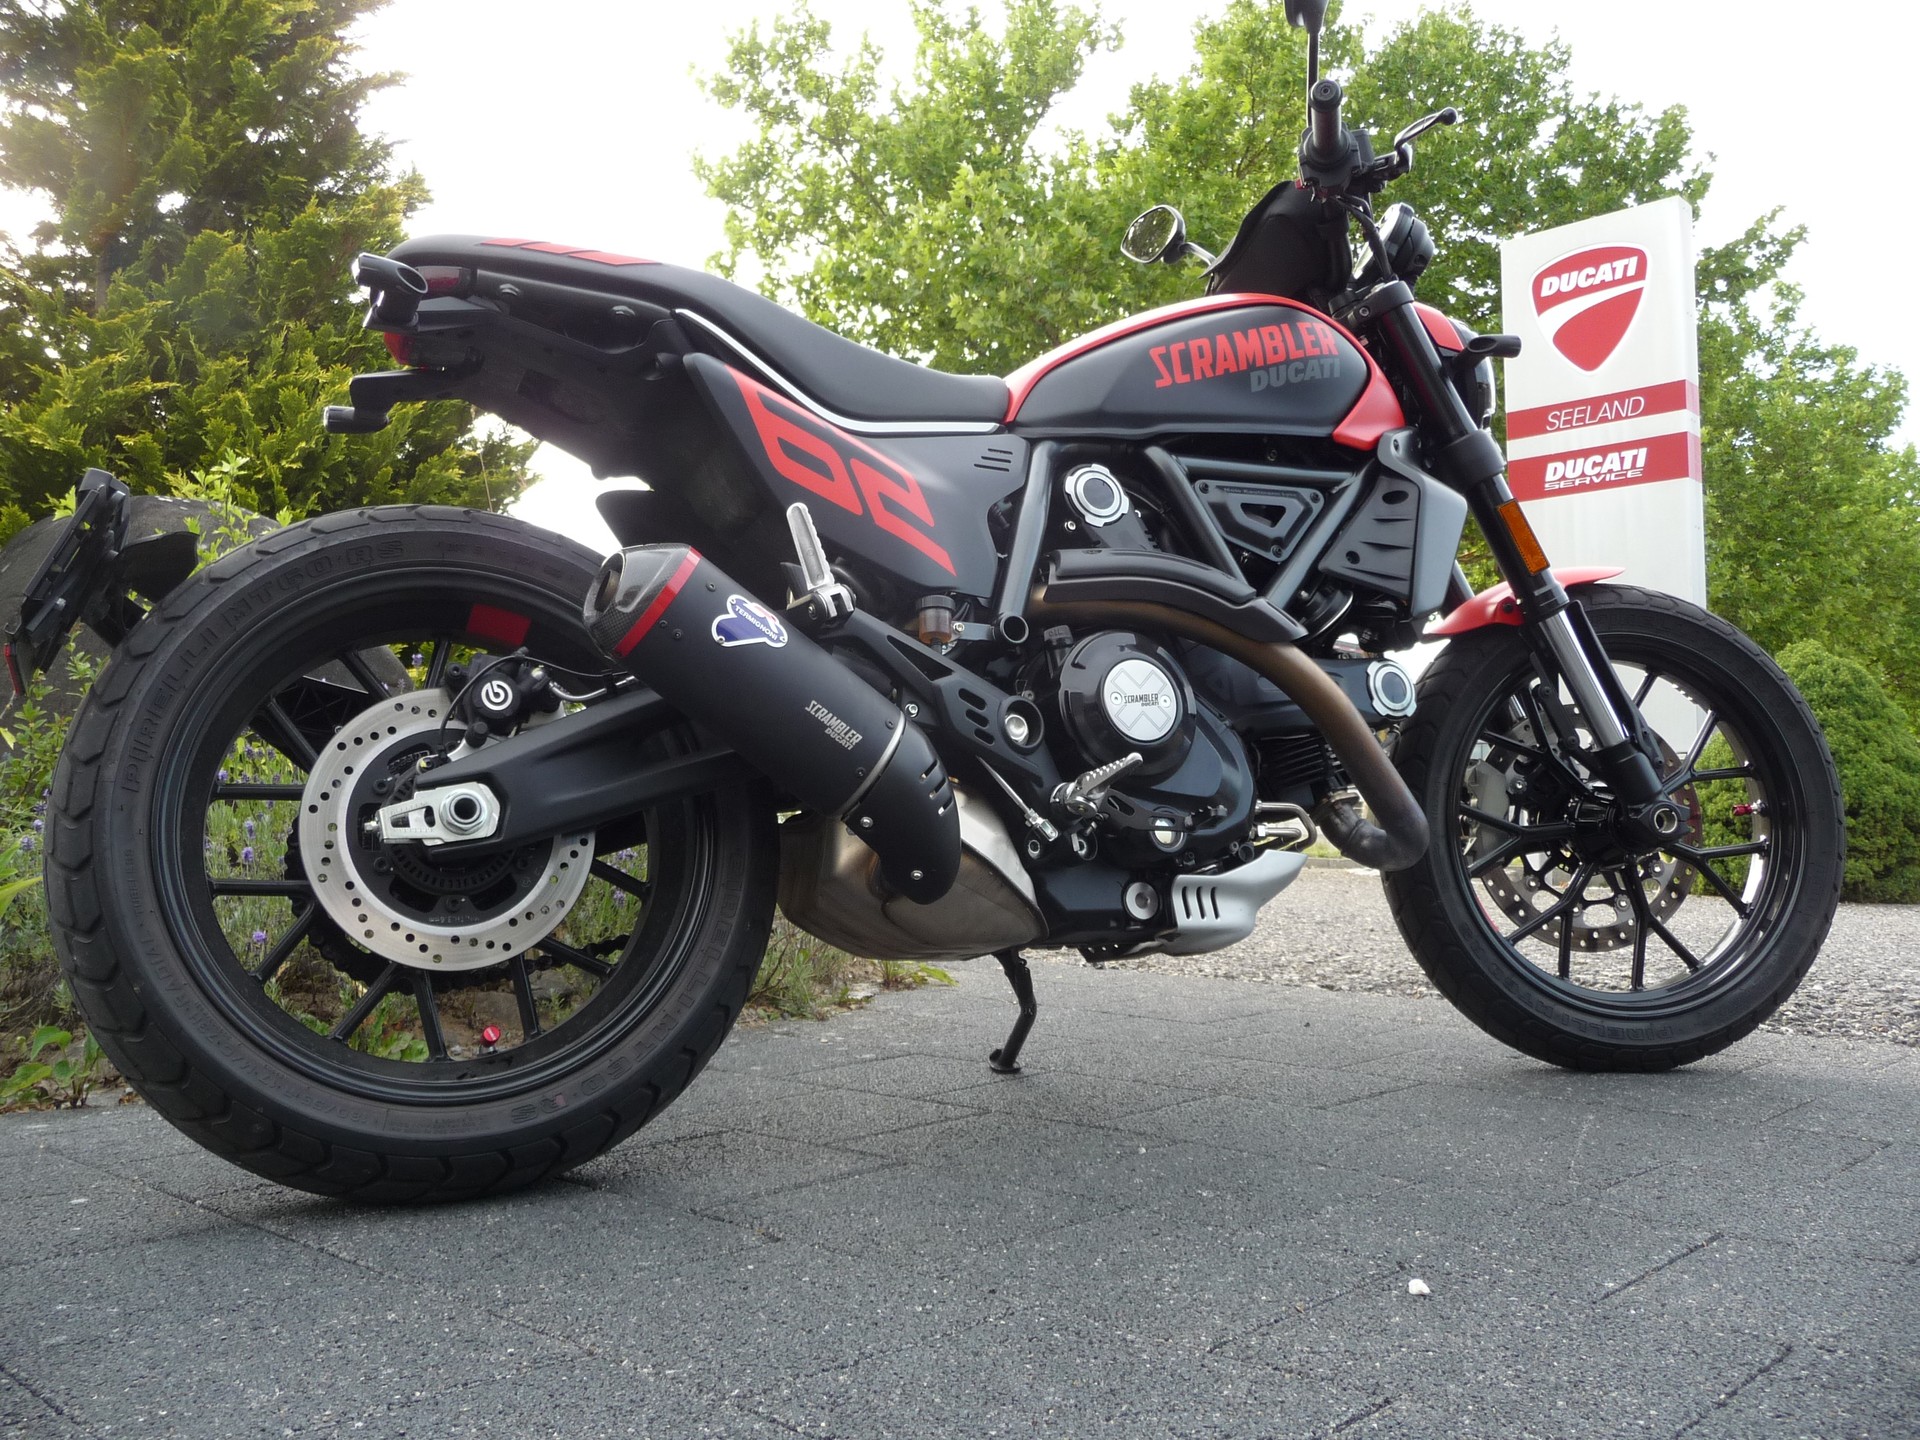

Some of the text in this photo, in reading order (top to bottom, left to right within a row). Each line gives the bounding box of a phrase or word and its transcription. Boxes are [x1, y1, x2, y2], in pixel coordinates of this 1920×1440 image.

[1540, 256, 1638, 297] DUCATI
[1148, 321, 1339, 389] SCRAMBLER
[1250, 357, 1341, 393] DUCATI
[1546, 396, 1645, 431] SEELAND
[1544, 469, 1643, 491] SERVICE
[1545, 447, 1648, 482] DUCATI
[734, 604, 778, 642] TERMIGNONI
[121, 627, 219, 793] PIRELLI
[1123, 693, 1159, 705] SCRAMBLER
[805, 700, 863, 746] SCRAMBLER
[824, 728, 854, 751] DUCATI
